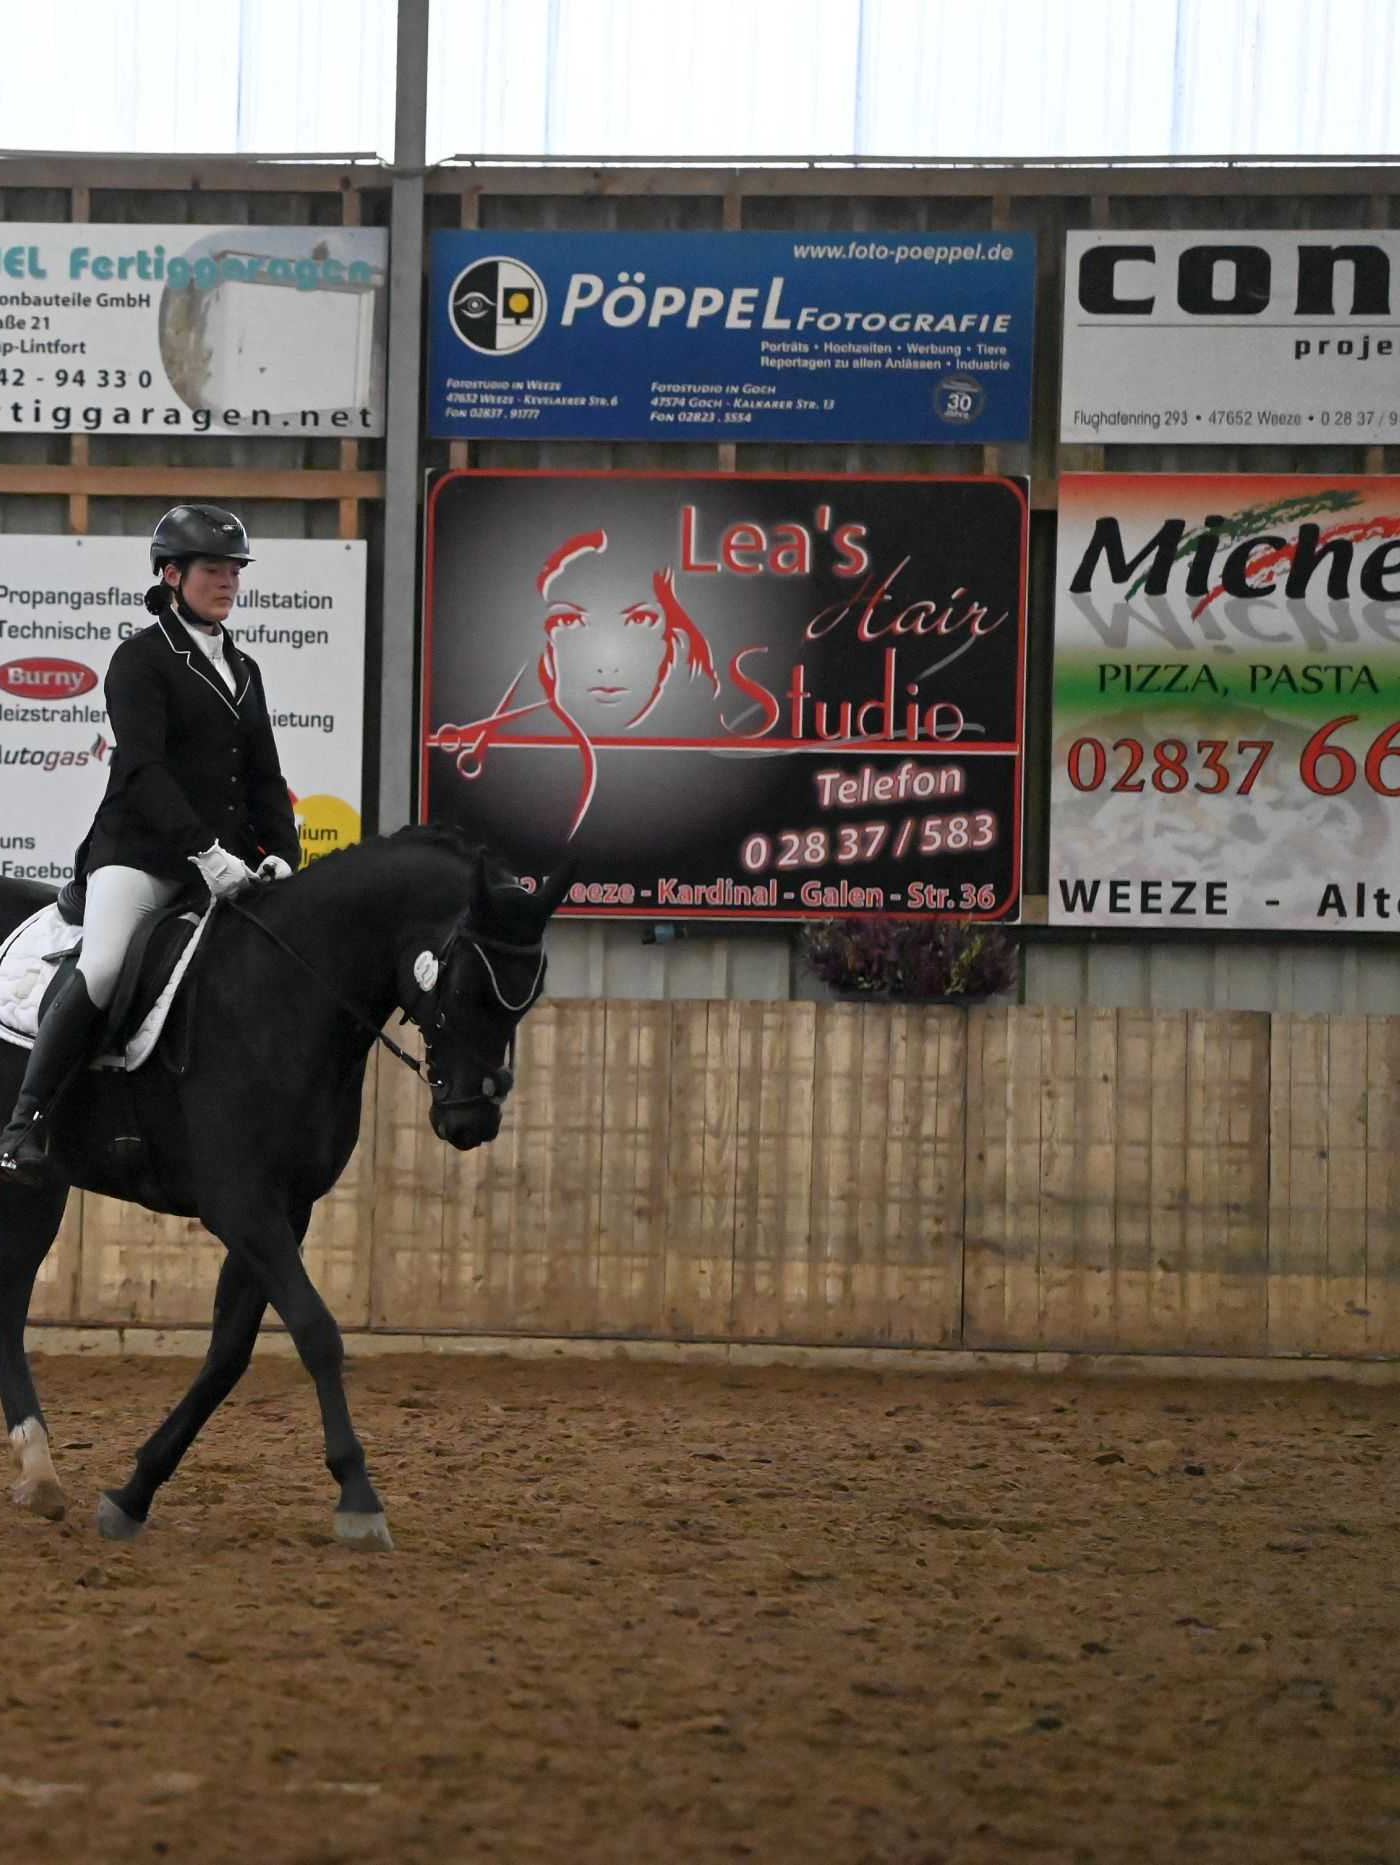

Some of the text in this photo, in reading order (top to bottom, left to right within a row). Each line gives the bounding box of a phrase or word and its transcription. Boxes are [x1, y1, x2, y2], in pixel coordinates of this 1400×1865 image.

[793, 242, 1013, 264] www.foto-poeppel.de
[69, 245, 373, 291] Fertiggaragen
[96, 293, 151, 308] GmbH
[31, 316, 50, 330] 21
[760, 341, 1007, 356] Porträts Hochzeiten Werbung Tiere
[1294, 336, 1393, 360] proje
[760, 357, 1010, 370] Reportagen zu allen Anlässen Industrie
[55, 369, 86, 388] 94
[97, 370, 127, 388] 33
[138, 370, 152, 388] 0
[947, 393, 972, 412] 30
[1073, 411, 1161, 429] Flughafenring
[1164, 412, 1188, 426] 293
[1208, 411, 1252, 427] 47652
[1257, 411, 1301, 426] Weeze
[1321, 411, 1330, 426] 0
[1334, 411, 1352, 426] 28
[1356, 411, 1374, 426] 37
[1389, 411, 1398, 426] 9
[681, 504, 868, 577] Lea's
[803, 554, 1010, 642] Hair
[117, 622, 145, 641] Ga
[7, 667, 85, 692] Burny
[1096, 664, 1380, 697] PIZZA, PASTA
[719, 646, 965, 741] Studio
[272, 709, 334, 733] ietung
[1067, 737, 1274, 795] 02837
[817, 764, 962, 806] Telefon
[0, 835, 36, 850] uns
[297, 823, 338, 841] lium
[744, 836, 768, 870] 0
[777, 831, 826, 867] 28
[838, 825, 886, 861] 37
[921, 814, 994, 852] 583
[2, 861, 75, 879] Facebo
[568, 882, 636, 904] eeze
[658, 878, 778, 905] Kardinal
[800, 879, 884, 908] Galen
[907, 881, 955, 909] Str.
[959, 883, 996, 909] 36
[1058, 879, 1228, 916] WEEZE
[1316, 882, 1400, 918] Alt
